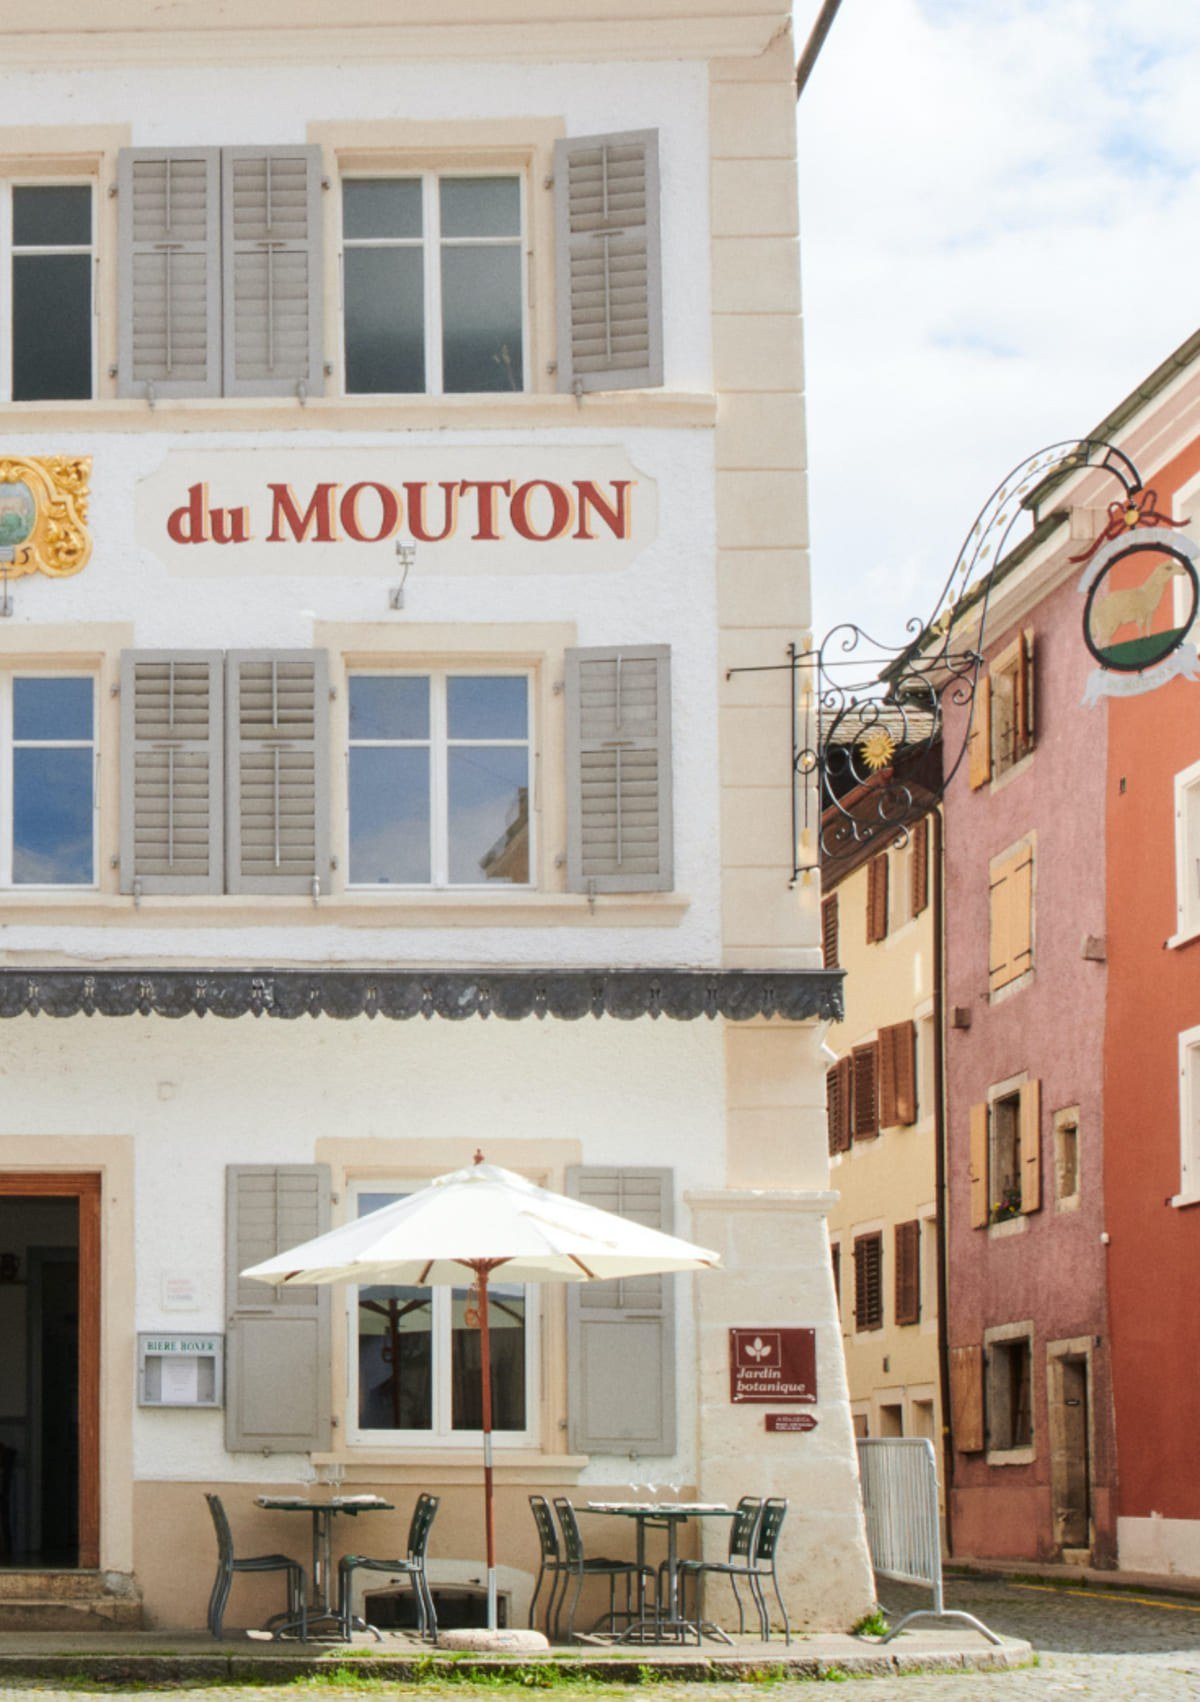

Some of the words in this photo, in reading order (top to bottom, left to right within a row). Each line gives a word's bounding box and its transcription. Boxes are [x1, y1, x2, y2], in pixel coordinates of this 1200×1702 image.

[166, 481, 256, 545] du
[265, 478, 638, 544] MOUTON
[736, 1367, 781, 1379] Jardin
[736, 1380, 806, 1394] botanique
